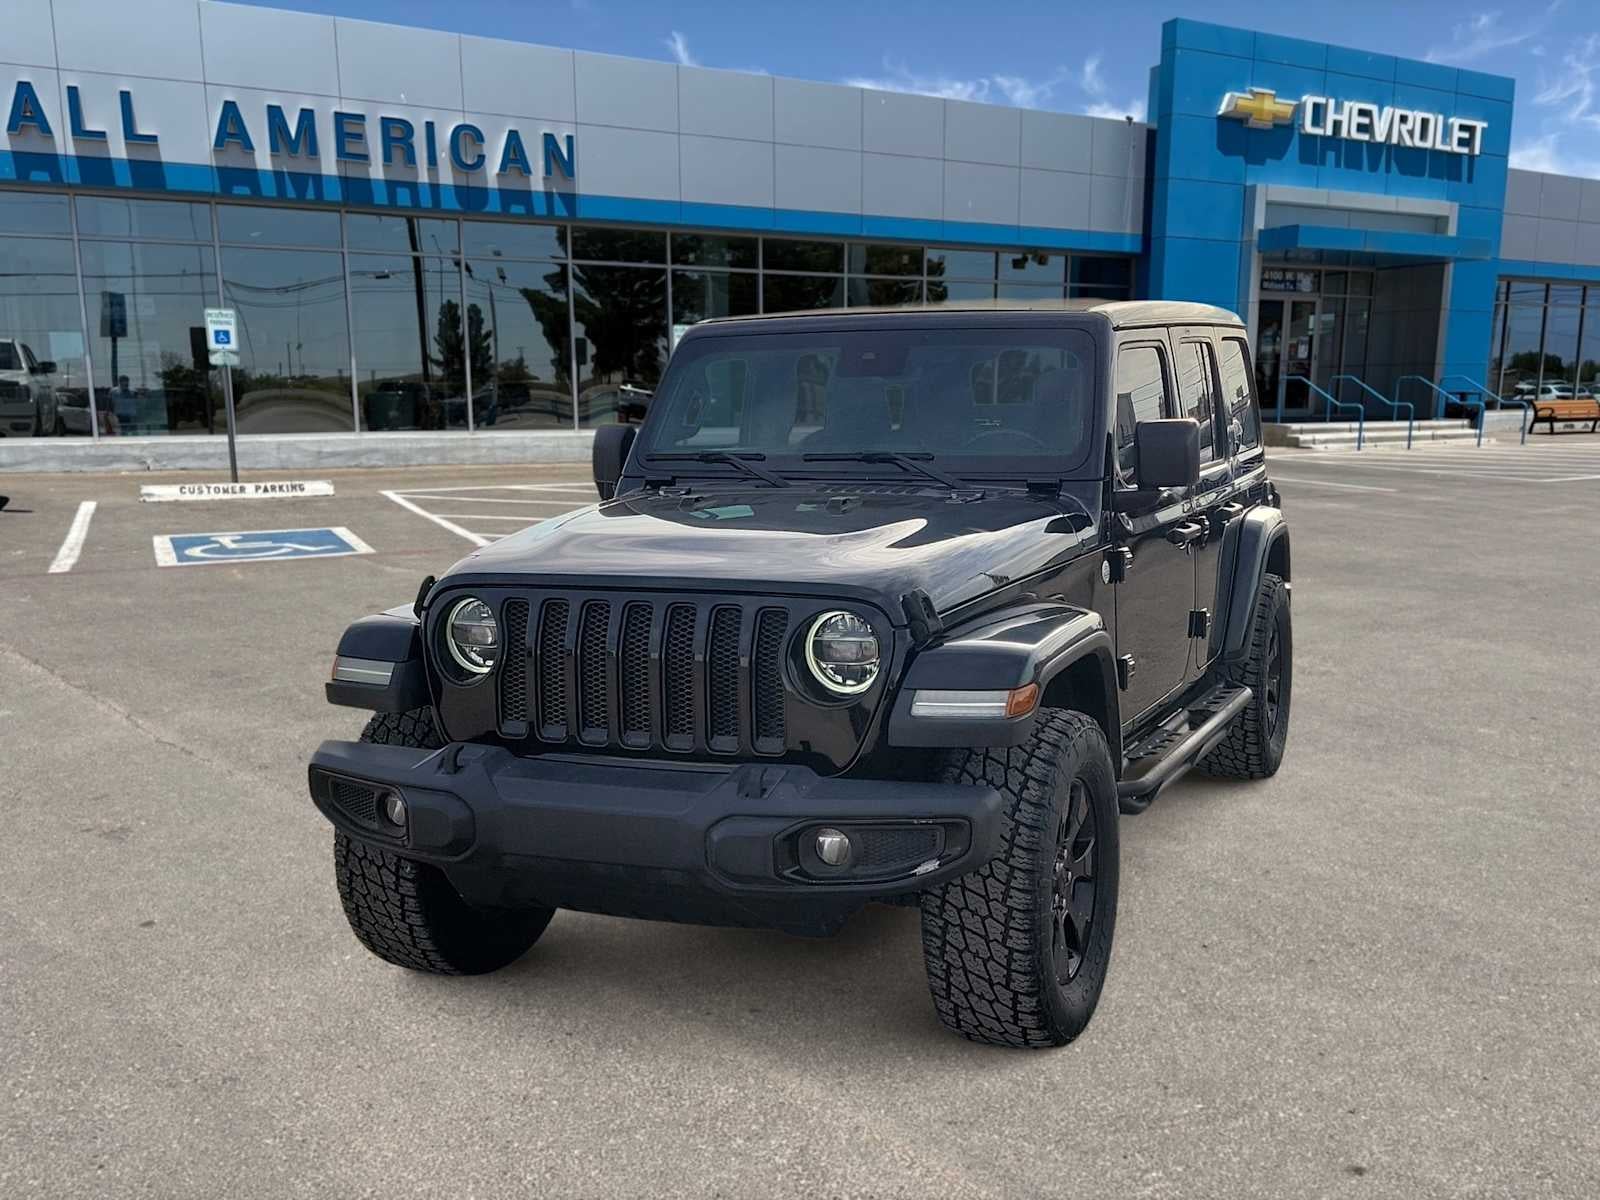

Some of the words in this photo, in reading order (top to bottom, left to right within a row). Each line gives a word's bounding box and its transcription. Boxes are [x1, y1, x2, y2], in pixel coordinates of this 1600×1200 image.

[6, 80, 158, 144] ALL
[213, 100, 576, 179] AMERICAN
[1301, 94, 1488, 155] CHEVROLET
[179, 485, 246, 495] CUSTOMER
[255, 483, 305, 493] PARKING
